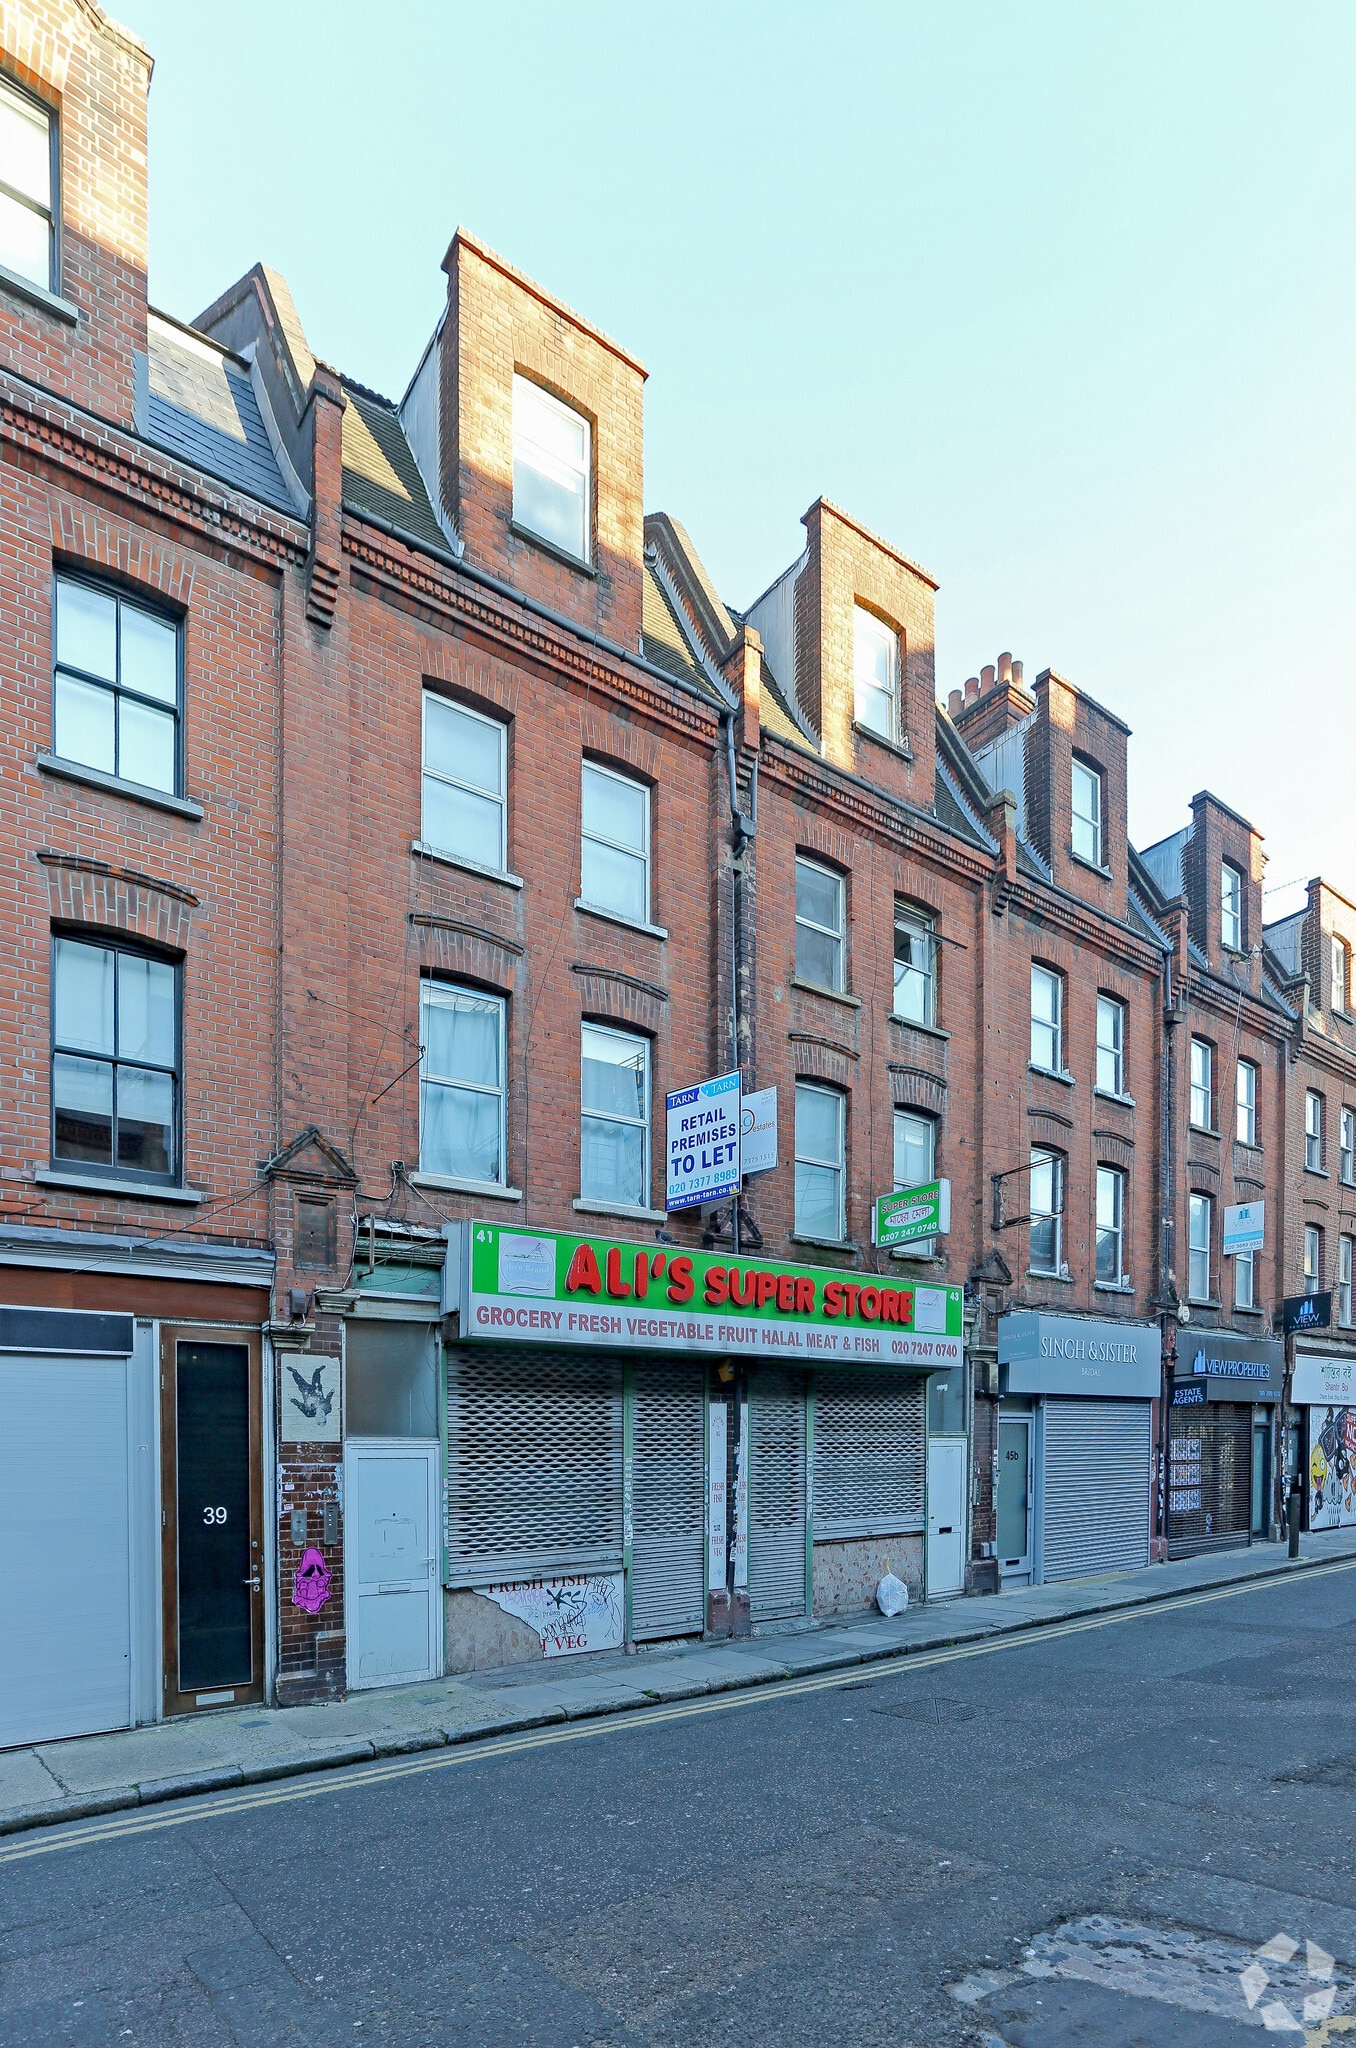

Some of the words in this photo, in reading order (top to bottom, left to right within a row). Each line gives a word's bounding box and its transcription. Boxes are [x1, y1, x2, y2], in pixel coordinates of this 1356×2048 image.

[670, 1092, 695, 1106] TARN
[711, 1079, 736, 1095] TARN
[681, 1107, 726, 1132] RETAIL
[752, 1121, 775, 1132] estates
[671, 1123, 736, 1153] PREMISES
[671, 1154, 695, 1176] TO
[702, 1142, 736, 1169] LET
[669, 1182, 686, 1195] 020
[689, 1175, 711, 1190] 7377
[714, 1168, 737, 1183] 8989
[669, 1184, 738, 1207] www.tarn-tarn.co.uk
[881, 1199, 909, 1214] SUPER
[911, 1190, 939, 1205] STORE
[880, 1231, 900, 1242] 0207
[901, 1227, 915, 1238] 247
[917, 1221, 937, 1233] 0740
[1233, 1218, 1256, 1227] VIEW
[476, 1229, 493, 1244] 41
[525, 1264, 549, 1273] Brand
[565, 1243, 695, 1304] ALI'S
[704, 1266, 816, 1313] SUPER
[822, 1281, 914, 1325] STORE
[949, 1291, 960, 1302] 43
[1293, 1313, 1320, 1324] VIEW
[476, 1305, 563, 1330] GROCERY
[568, 1312, 622, 1334] FRESH
[626, 1317, 714, 1341] VEGETABLE
[718, 1325, 758, 1344] FRUIT
[762, 1329, 803, 1348] HALAL
[806, 1332, 839, 1350] MEAT
[842, 1336, 852, 1351] &
[854, 1336, 880, 1353] FISH
[891, 1339, 909, 1355] 020
[911, 1341, 934, 1356] 7247
[935, 1343, 958, 1358] 0740
[1041, 1336, 1085, 1359] SINGH
[1088, 1341, 1100, 1361] &
[1100, 1341, 1138, 1364] SISTER
[1081, 1367, 1101, 1377] BRIDAL
[1206, 1359, 1228, 1375] VIEW
[1228, 1360, 1270, 1378] PROPERTIES
[1173, 1394, 1204, 1405] AGENTS
[1174, 1387, 1202, 1398] ESTATE
[1005, 1450, 1019, 1461] 45b
[711, 1482, 724, 1492] FRESH
[713, 1494, 723, 1503] FISH
[203, 1506, 227, 1525] 39
[711, 1536, 724, 1545] FRESH
[713, 1547, 723, 1557] VEG
[488, 1578, 544, 1594] FRESH
[552, 1574, 588, 1588] FISH
[554, 1633, 588, 1651] VEG
